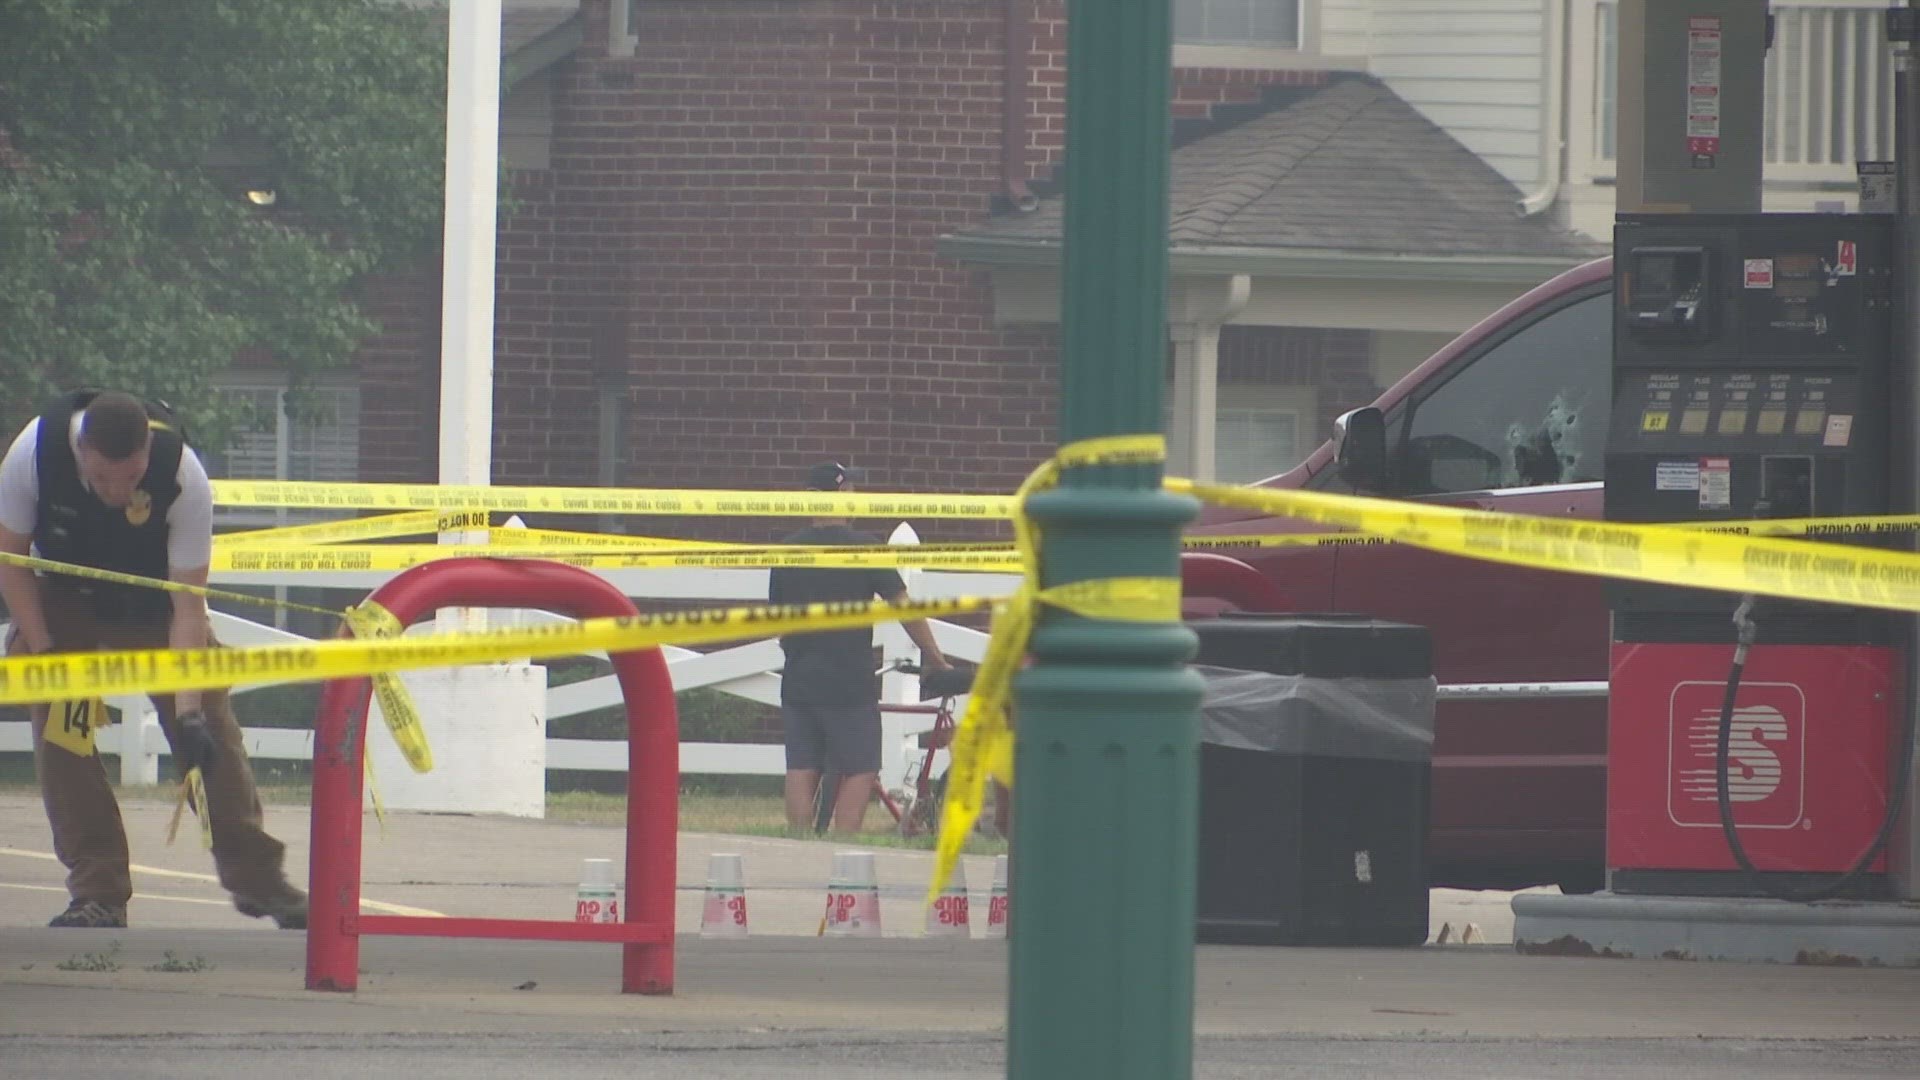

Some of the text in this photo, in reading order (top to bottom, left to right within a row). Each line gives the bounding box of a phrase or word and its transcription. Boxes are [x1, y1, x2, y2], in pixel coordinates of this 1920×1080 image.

[450, 513, 470, 528] NOT
[472, 512, 484, 526] DO
[1851, 523, 1871, 534] NO
[1440, 685, 1550, 696] RYSLER
[63, 701, 90, 739] 14
[1688, 705, 1788, 801] S
[939, 910, 968, 926] BIG
